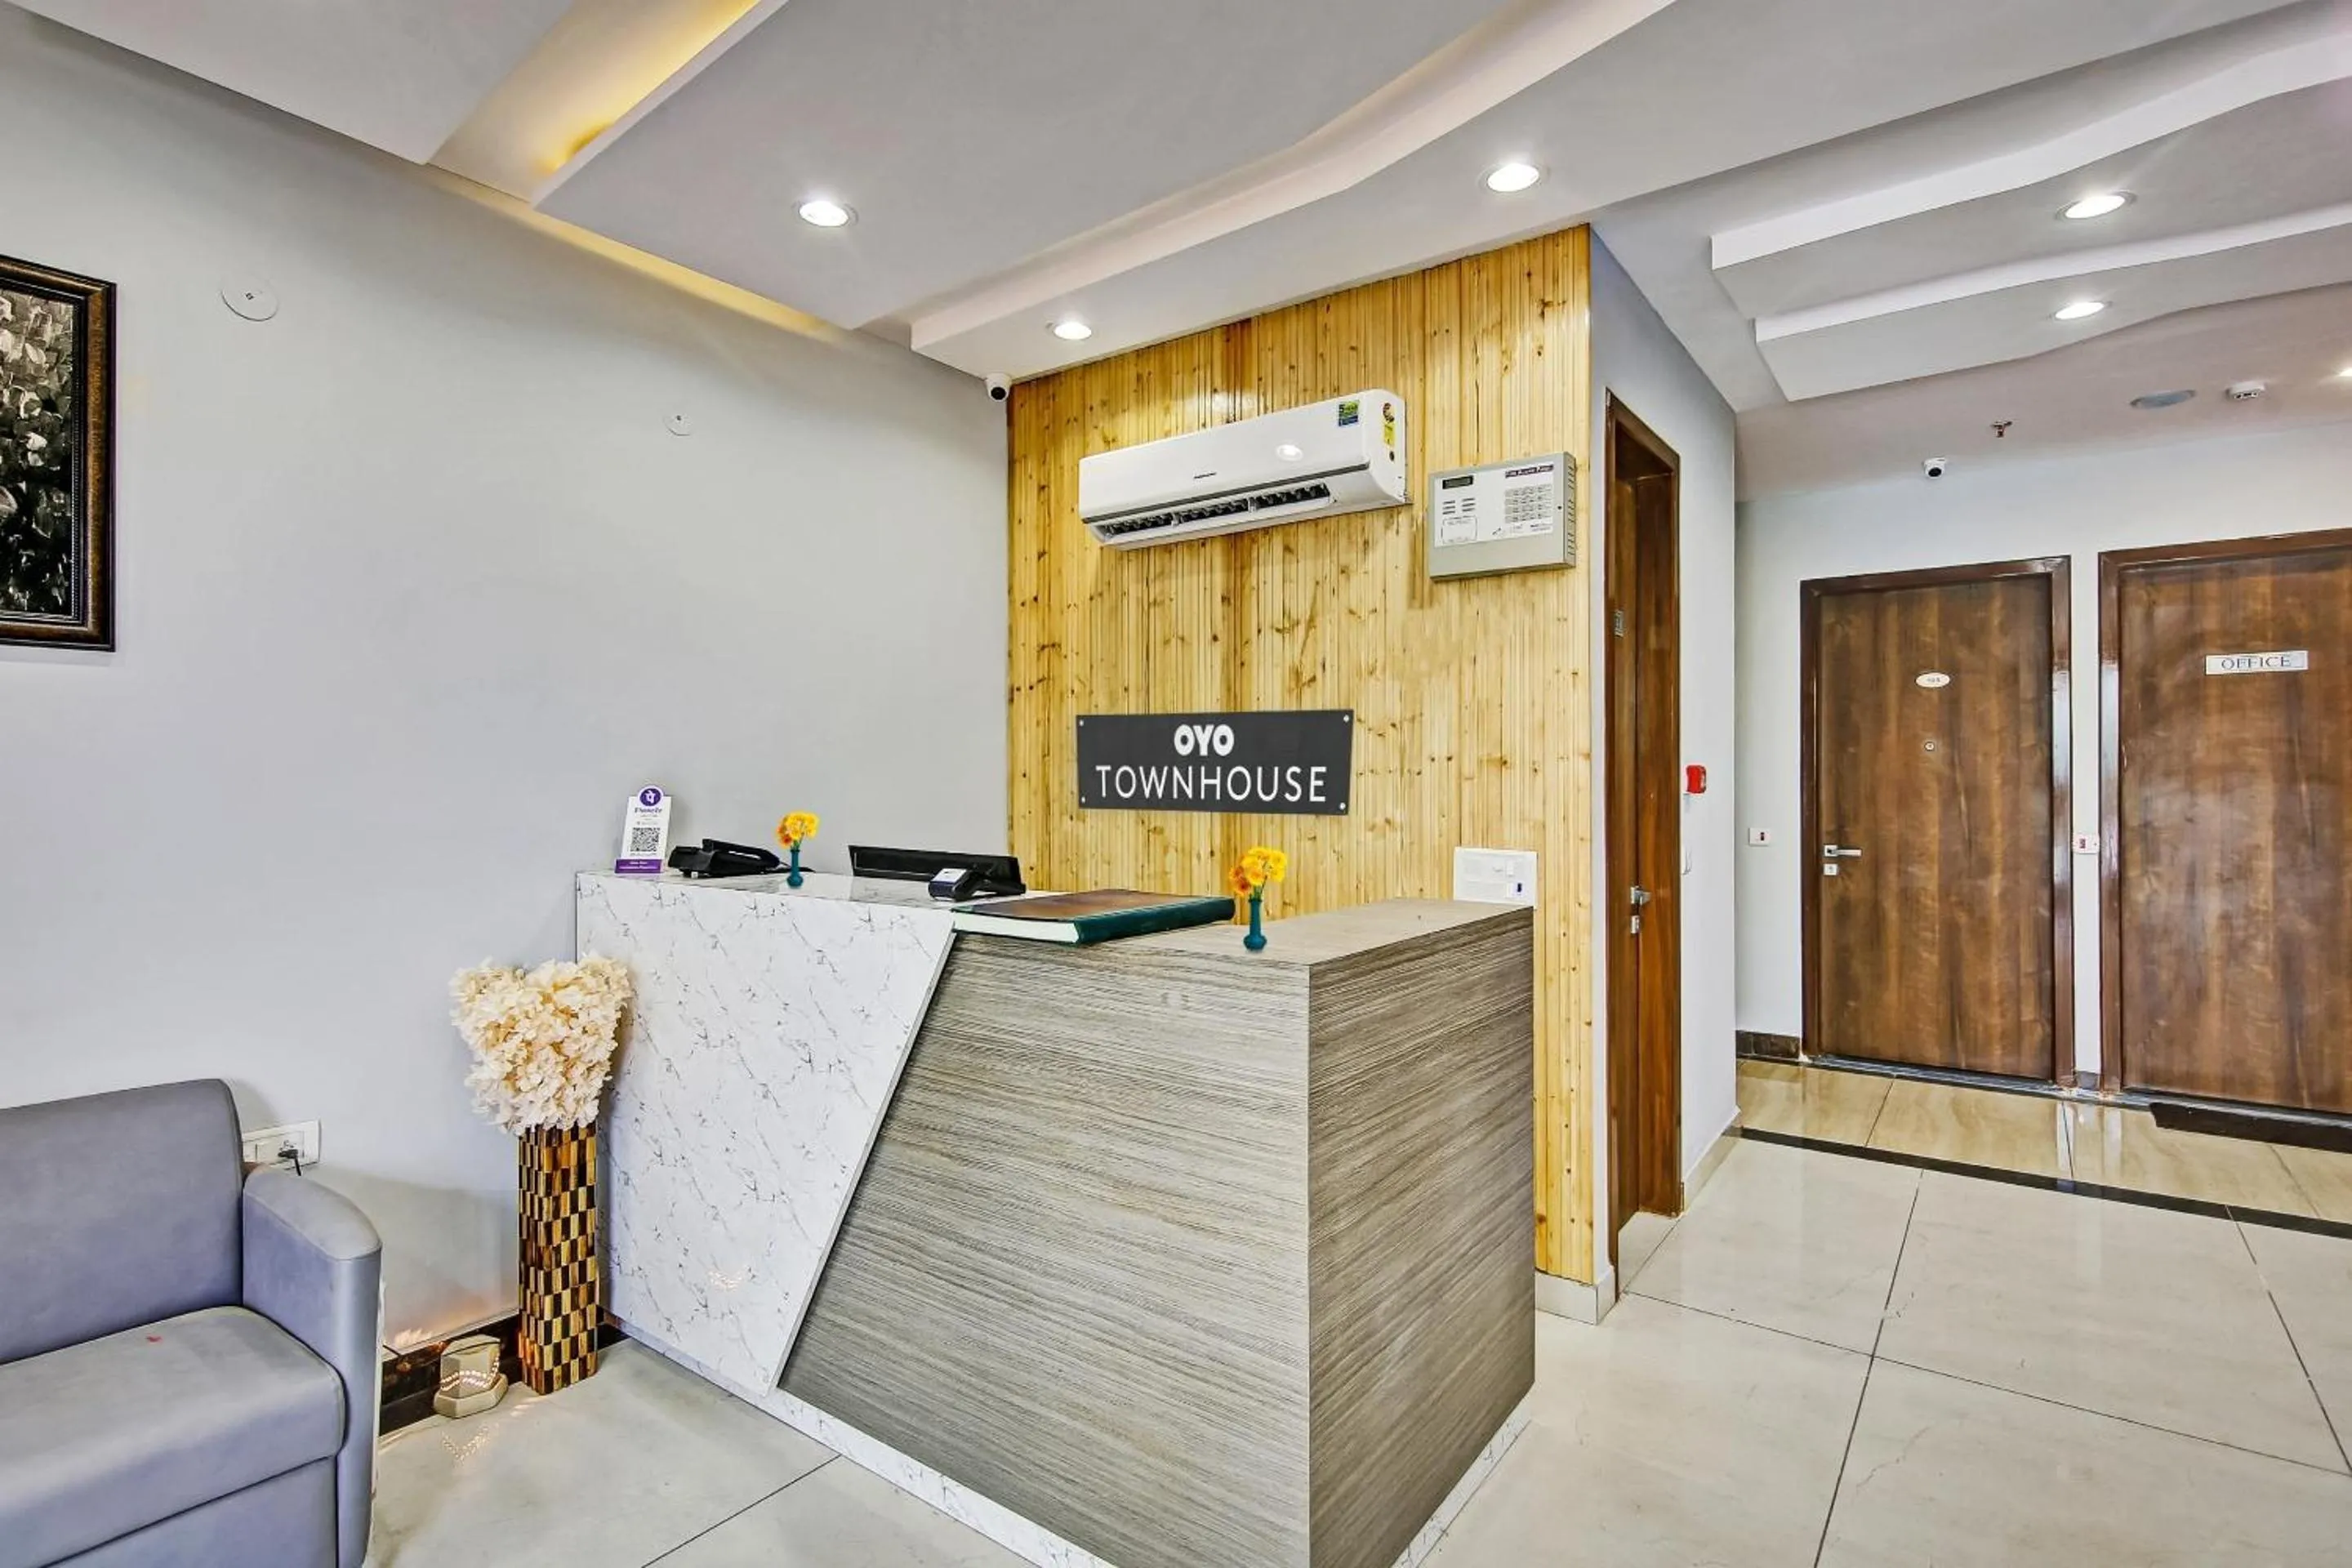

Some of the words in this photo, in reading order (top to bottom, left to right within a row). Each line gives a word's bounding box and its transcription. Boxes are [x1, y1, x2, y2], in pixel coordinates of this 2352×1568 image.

[2221, 656, 2291, 670] OFFICE
[1174, 724, 1235, 756] OYO
[1095, 765, 1327, 802] TOWNHOUSE
